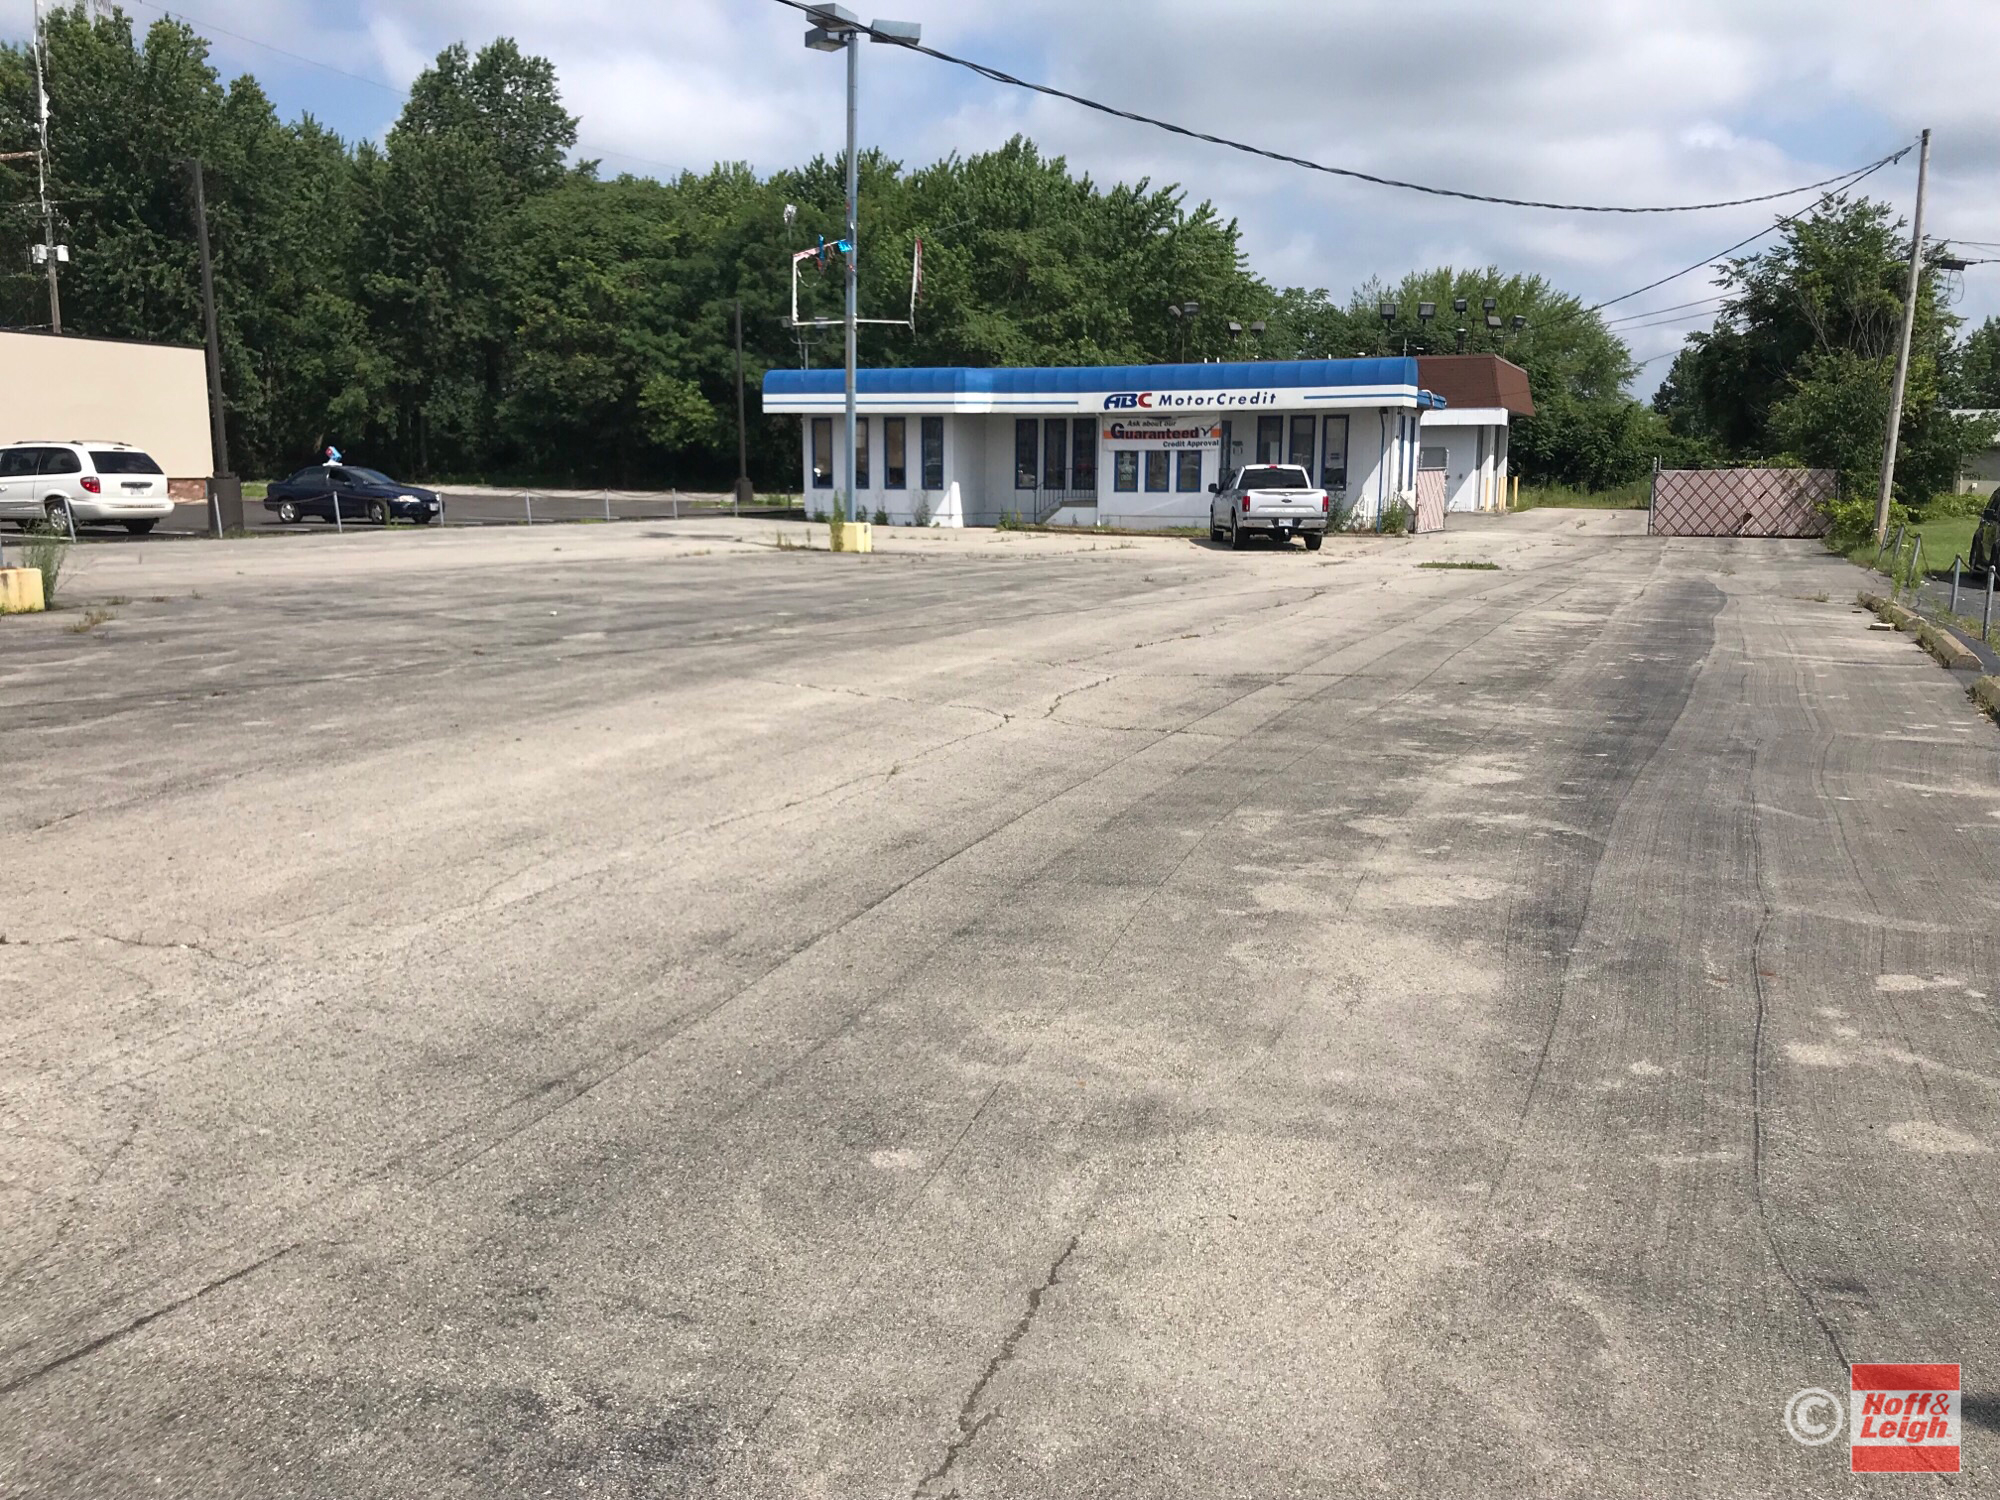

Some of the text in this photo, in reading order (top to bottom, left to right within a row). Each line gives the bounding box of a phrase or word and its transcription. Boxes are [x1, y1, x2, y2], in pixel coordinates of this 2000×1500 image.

[1104, 391, 1277, 410] ABC MotorCredit
[1110, 423, 1199, 439] Guaranteed
[1163, 439, 1219, 448] Credit Approval
